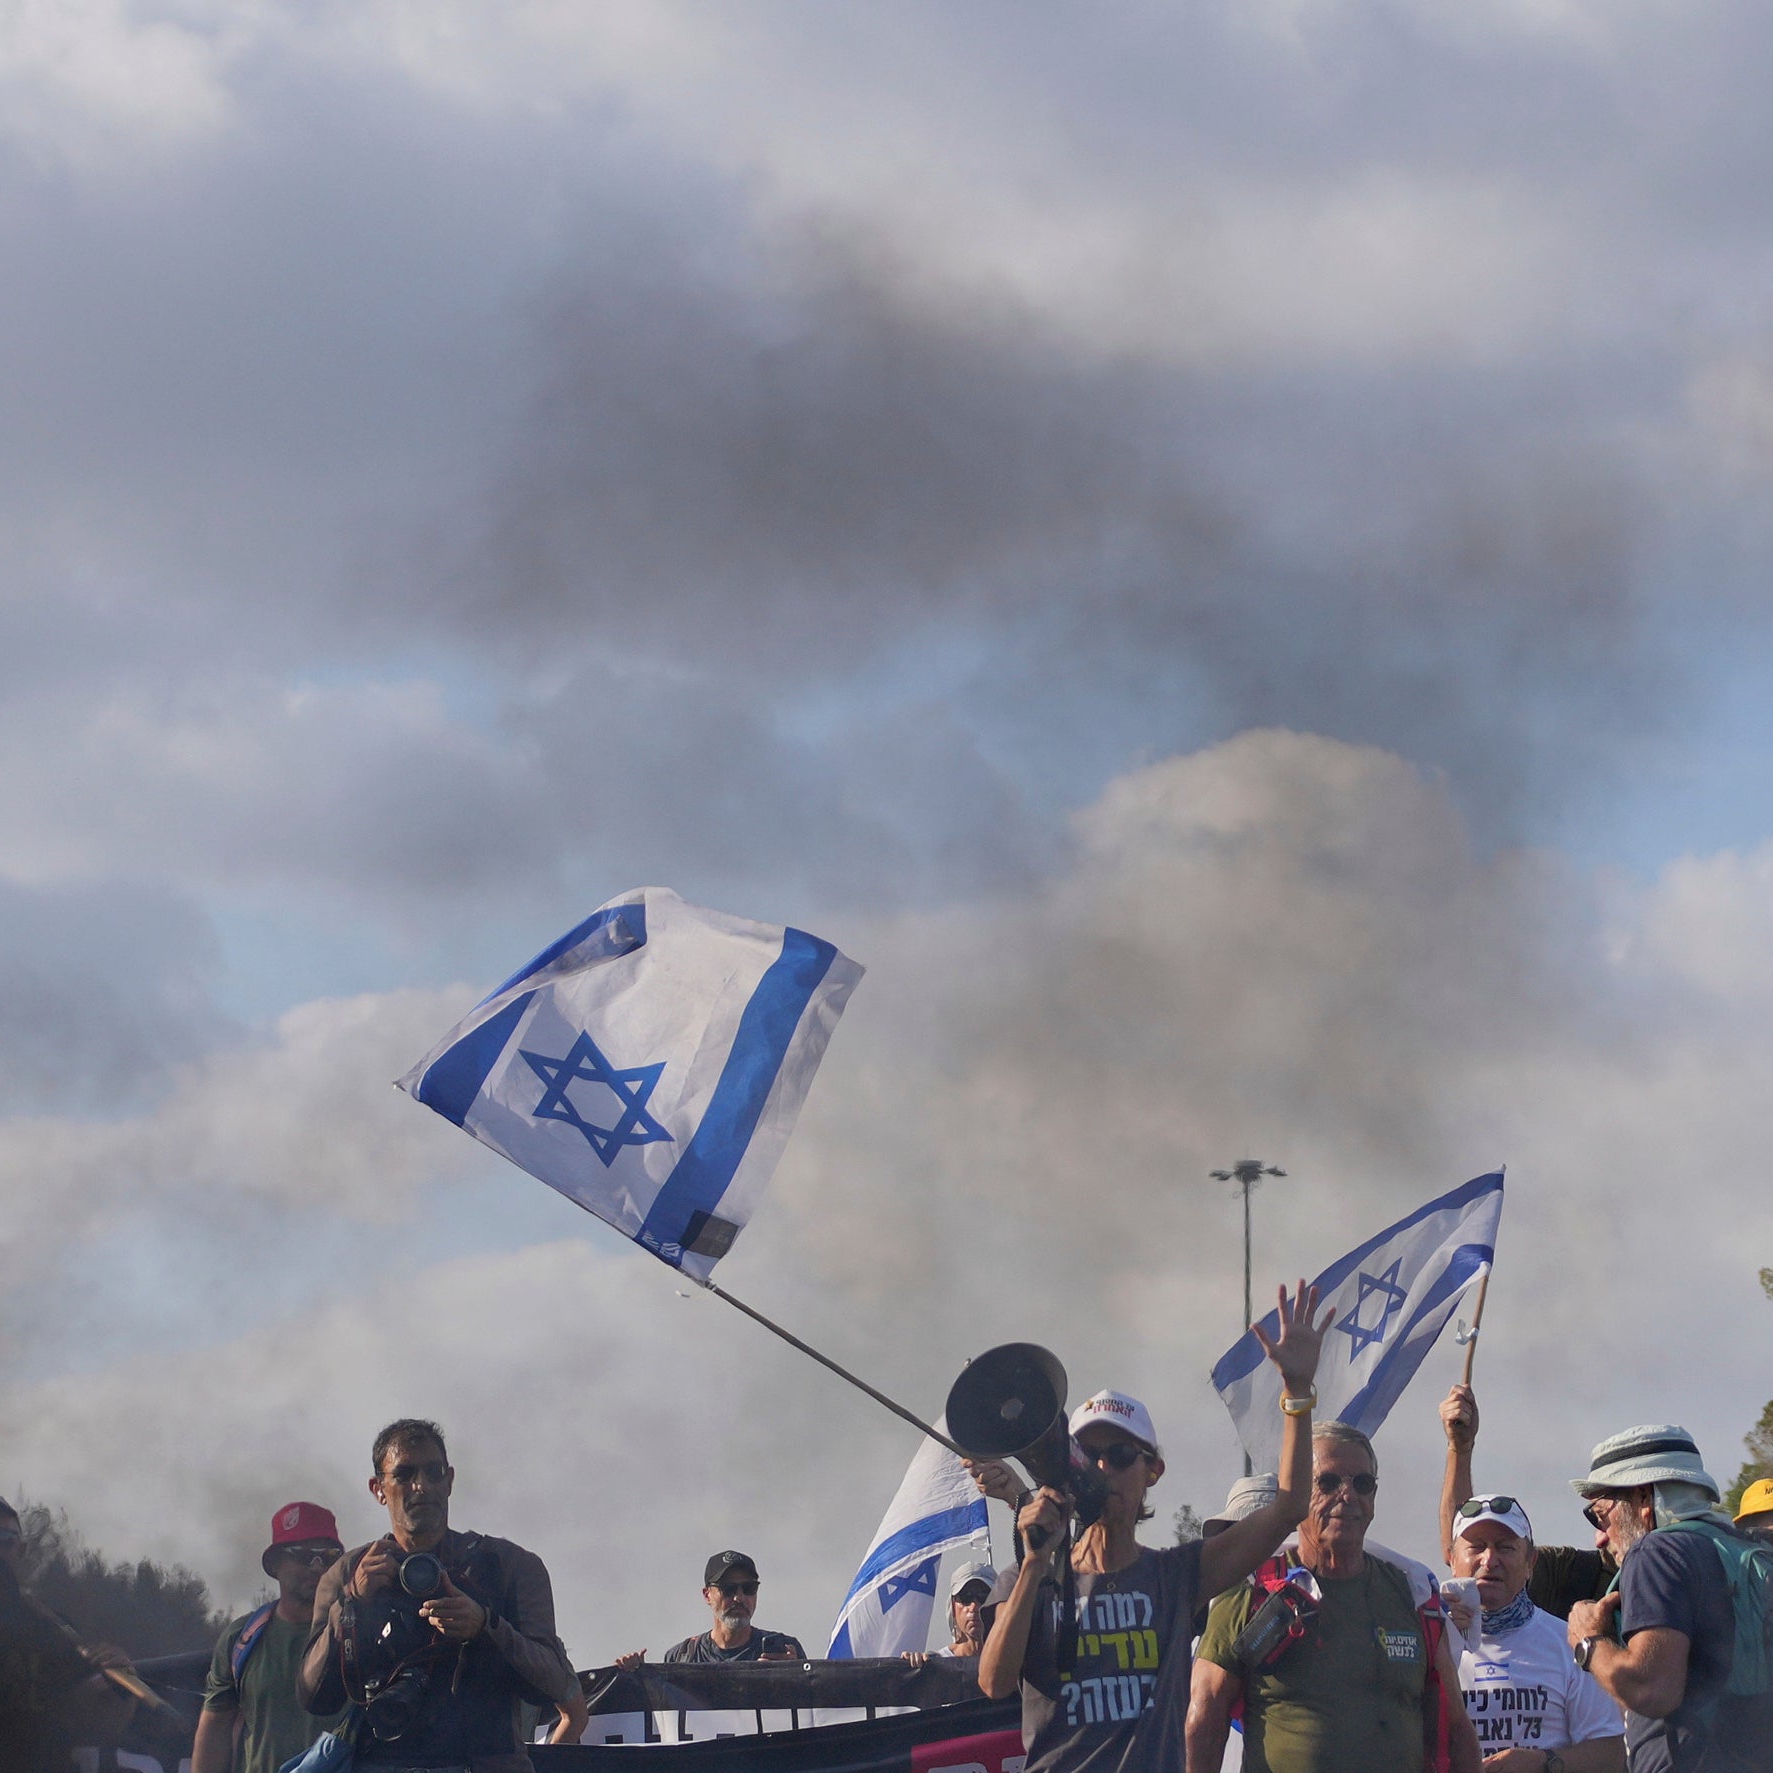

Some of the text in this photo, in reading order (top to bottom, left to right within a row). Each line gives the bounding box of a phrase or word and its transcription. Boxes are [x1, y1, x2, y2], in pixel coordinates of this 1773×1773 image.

[1095, 1591, 1153, 1630] למה
[1060, 1629, 1158, 1681] עדיי
[1493, 1685, 1548, 1711] לוחמי
[1473, 1716, 1513, 1741] נאב
